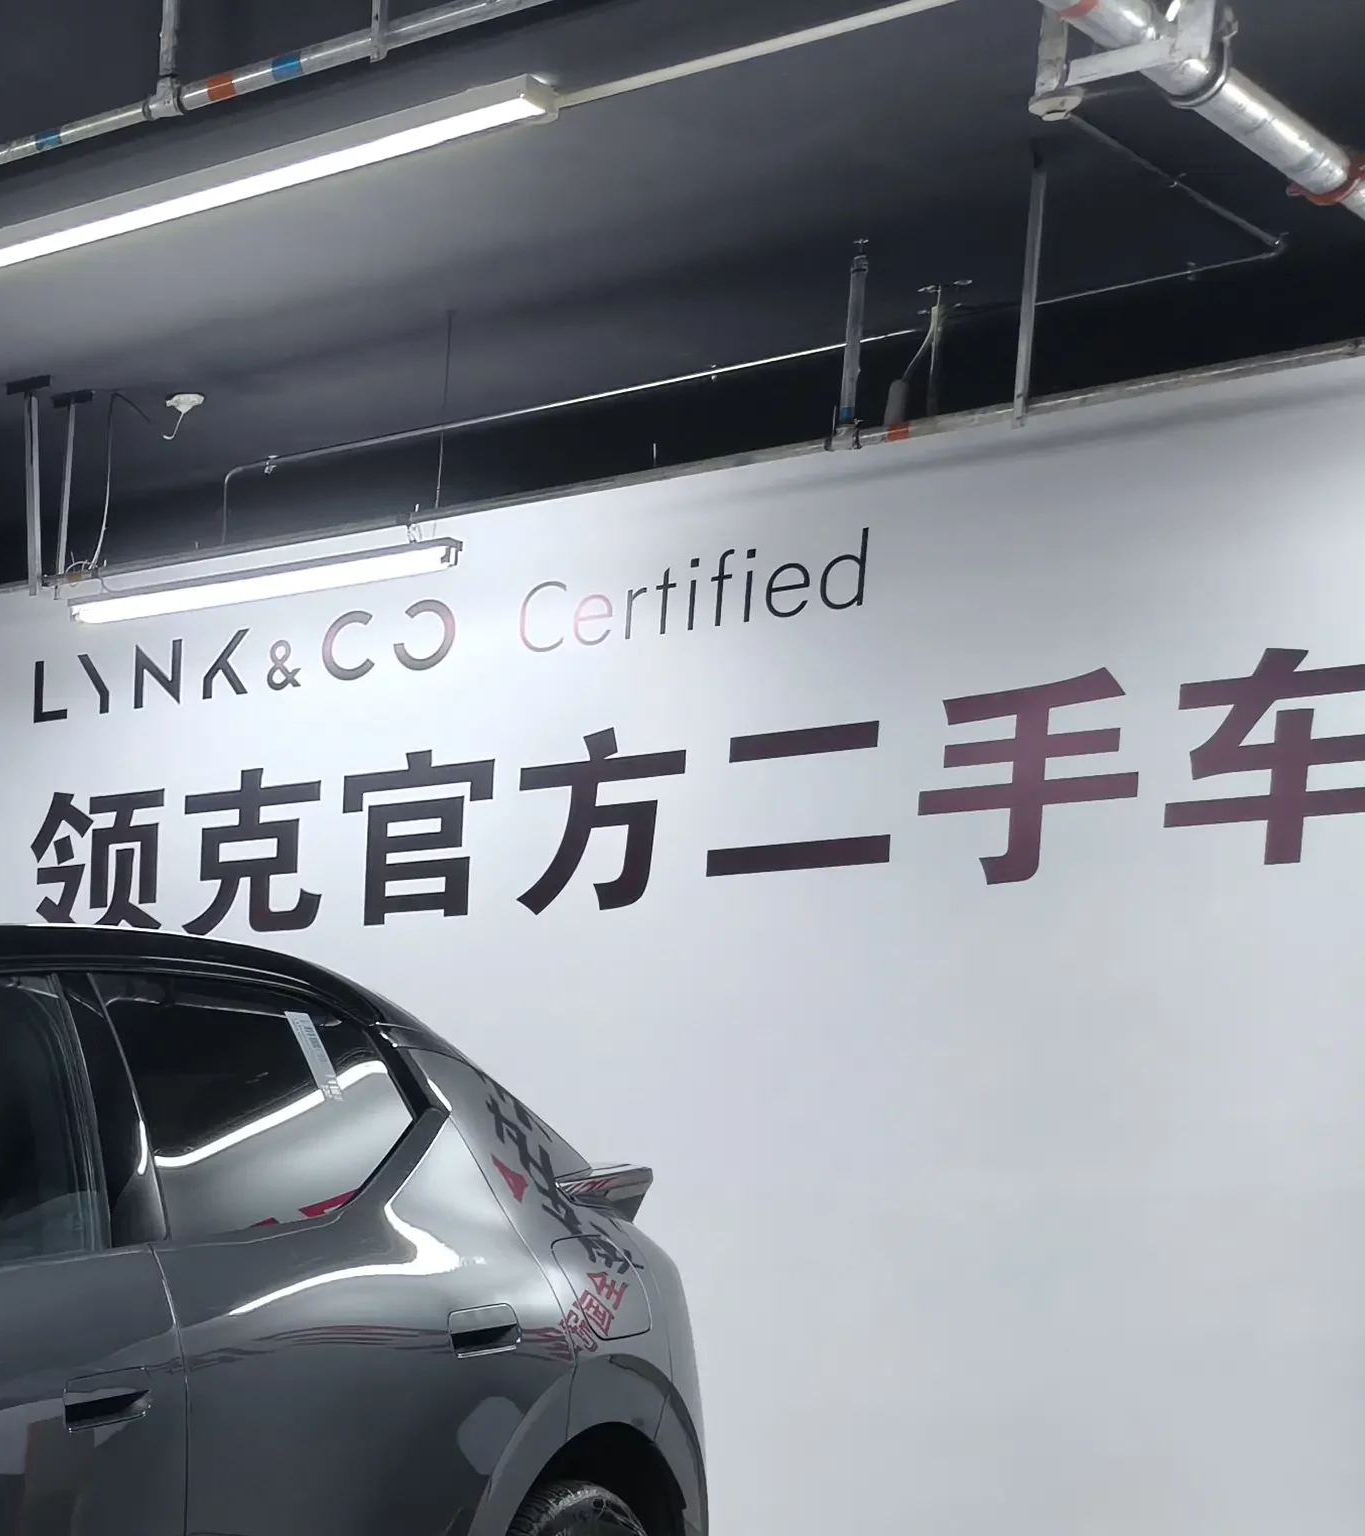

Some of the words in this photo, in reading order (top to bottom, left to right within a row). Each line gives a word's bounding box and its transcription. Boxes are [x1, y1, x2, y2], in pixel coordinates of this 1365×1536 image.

[32, 599, 457, 725] LYNK&CO
[518, 526, 871, 654] Certified
[29, 647, 1365, 936] 领克官方二手车
